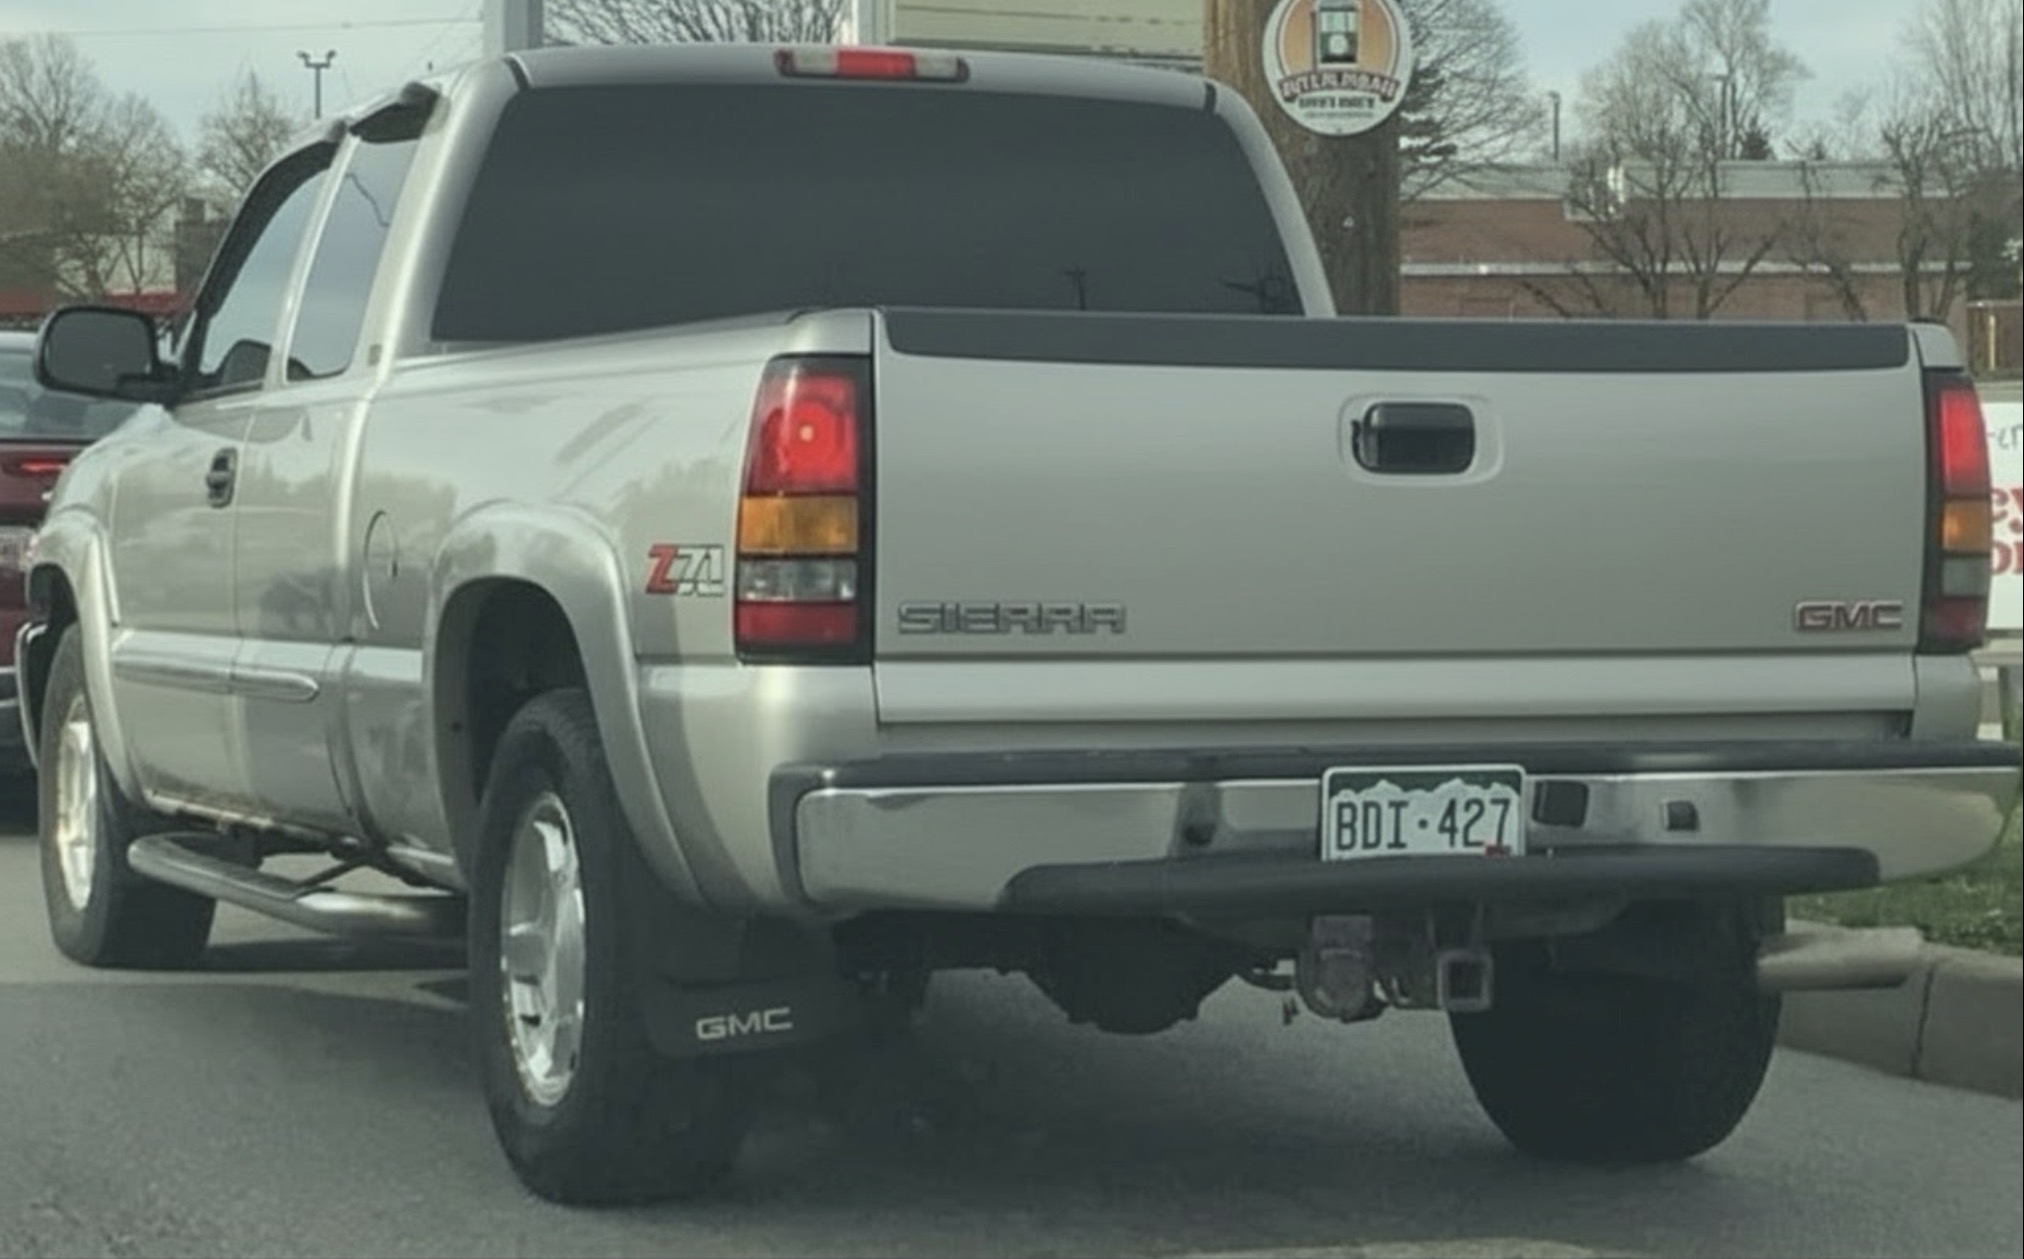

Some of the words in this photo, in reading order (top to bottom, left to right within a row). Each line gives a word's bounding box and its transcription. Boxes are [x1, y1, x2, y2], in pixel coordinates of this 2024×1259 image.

[645, 544, 724, 598] Z71
[898, 602, 1126, 635] SIERRA
[1795, 601, 1903, 631] GMC
[696, 1007, 793, 1039] GMC
